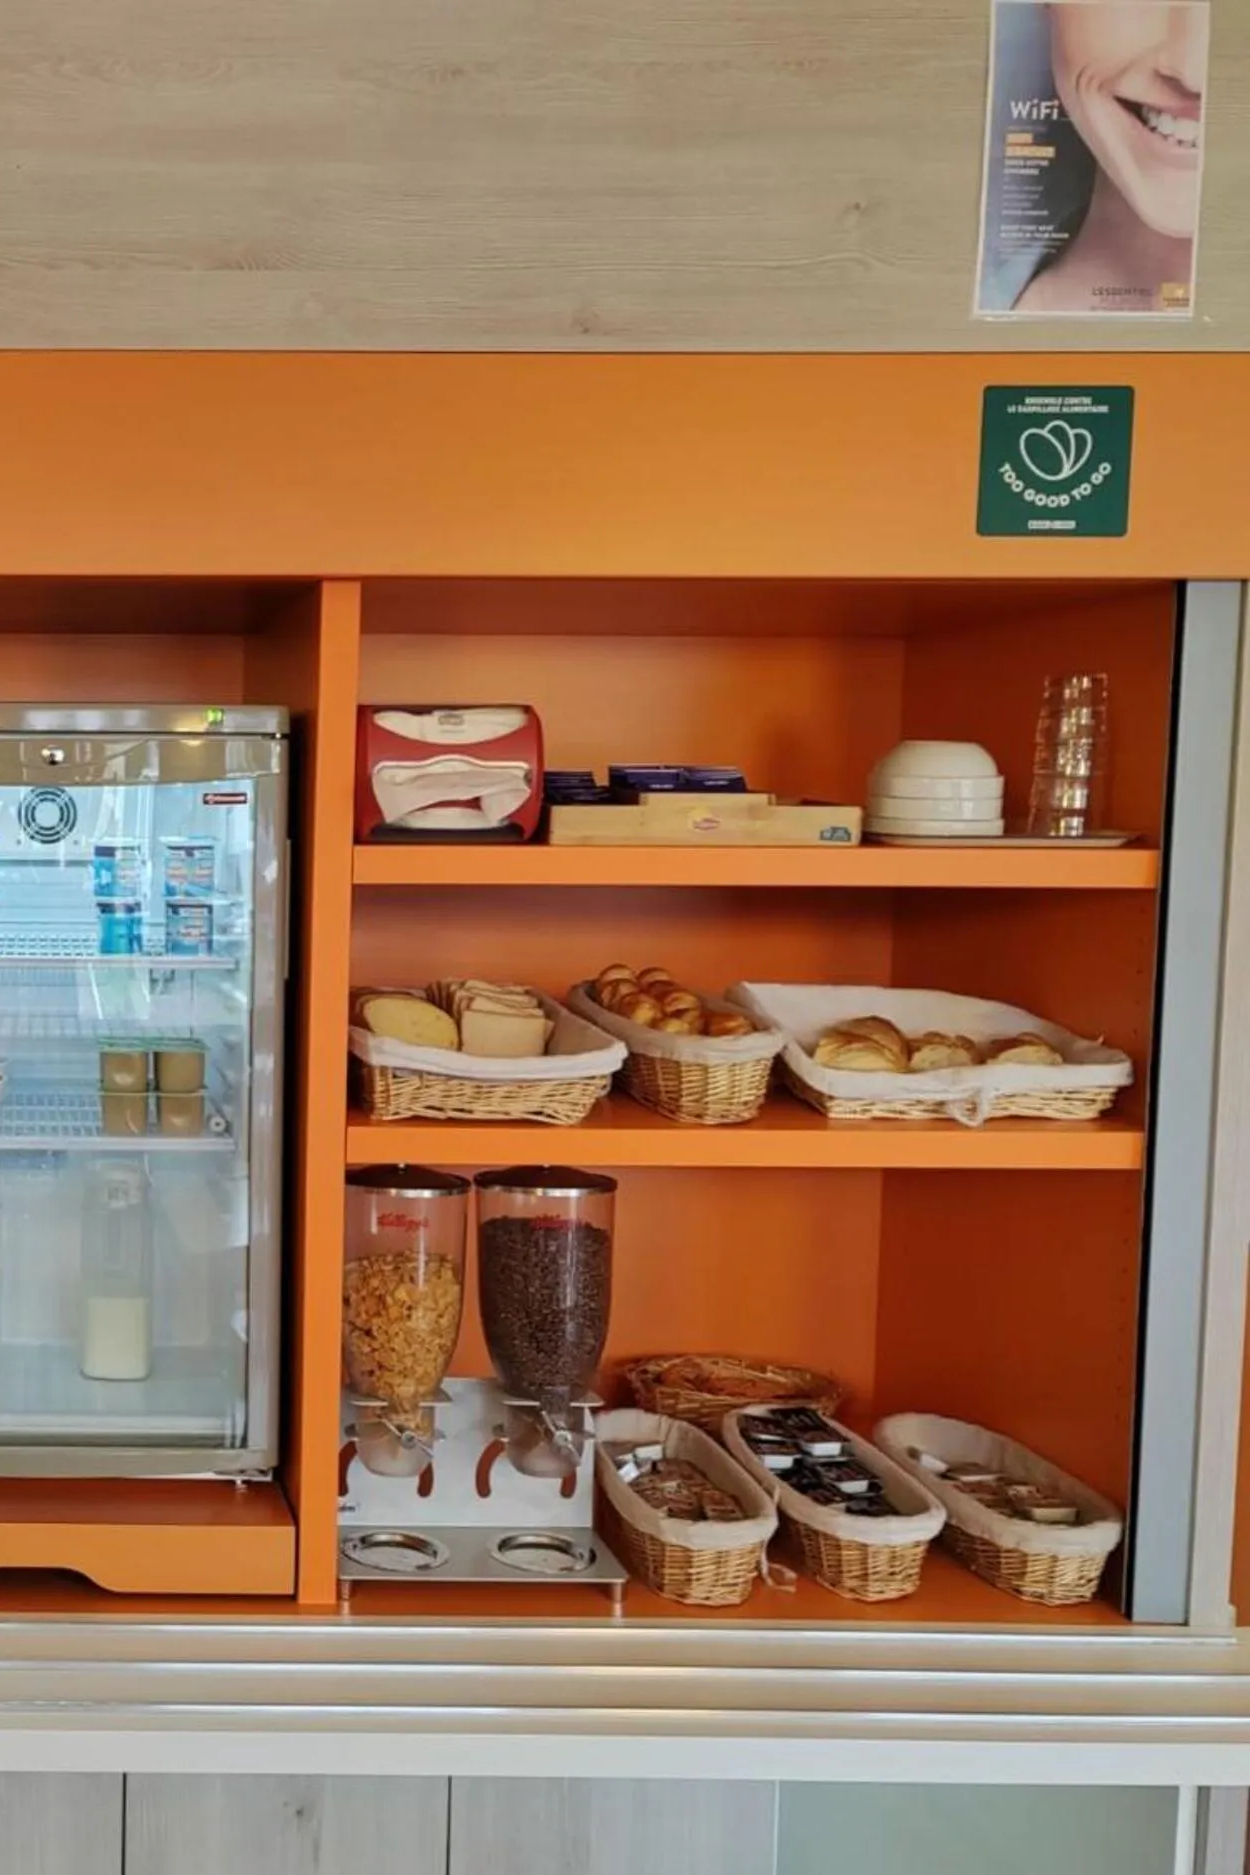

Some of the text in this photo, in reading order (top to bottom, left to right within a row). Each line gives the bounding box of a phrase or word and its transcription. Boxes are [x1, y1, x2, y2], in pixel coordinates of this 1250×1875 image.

[1010, 98, 1059, 120] WiFi
[998, 462, 1111, 508] TOO GOOD TO GO
